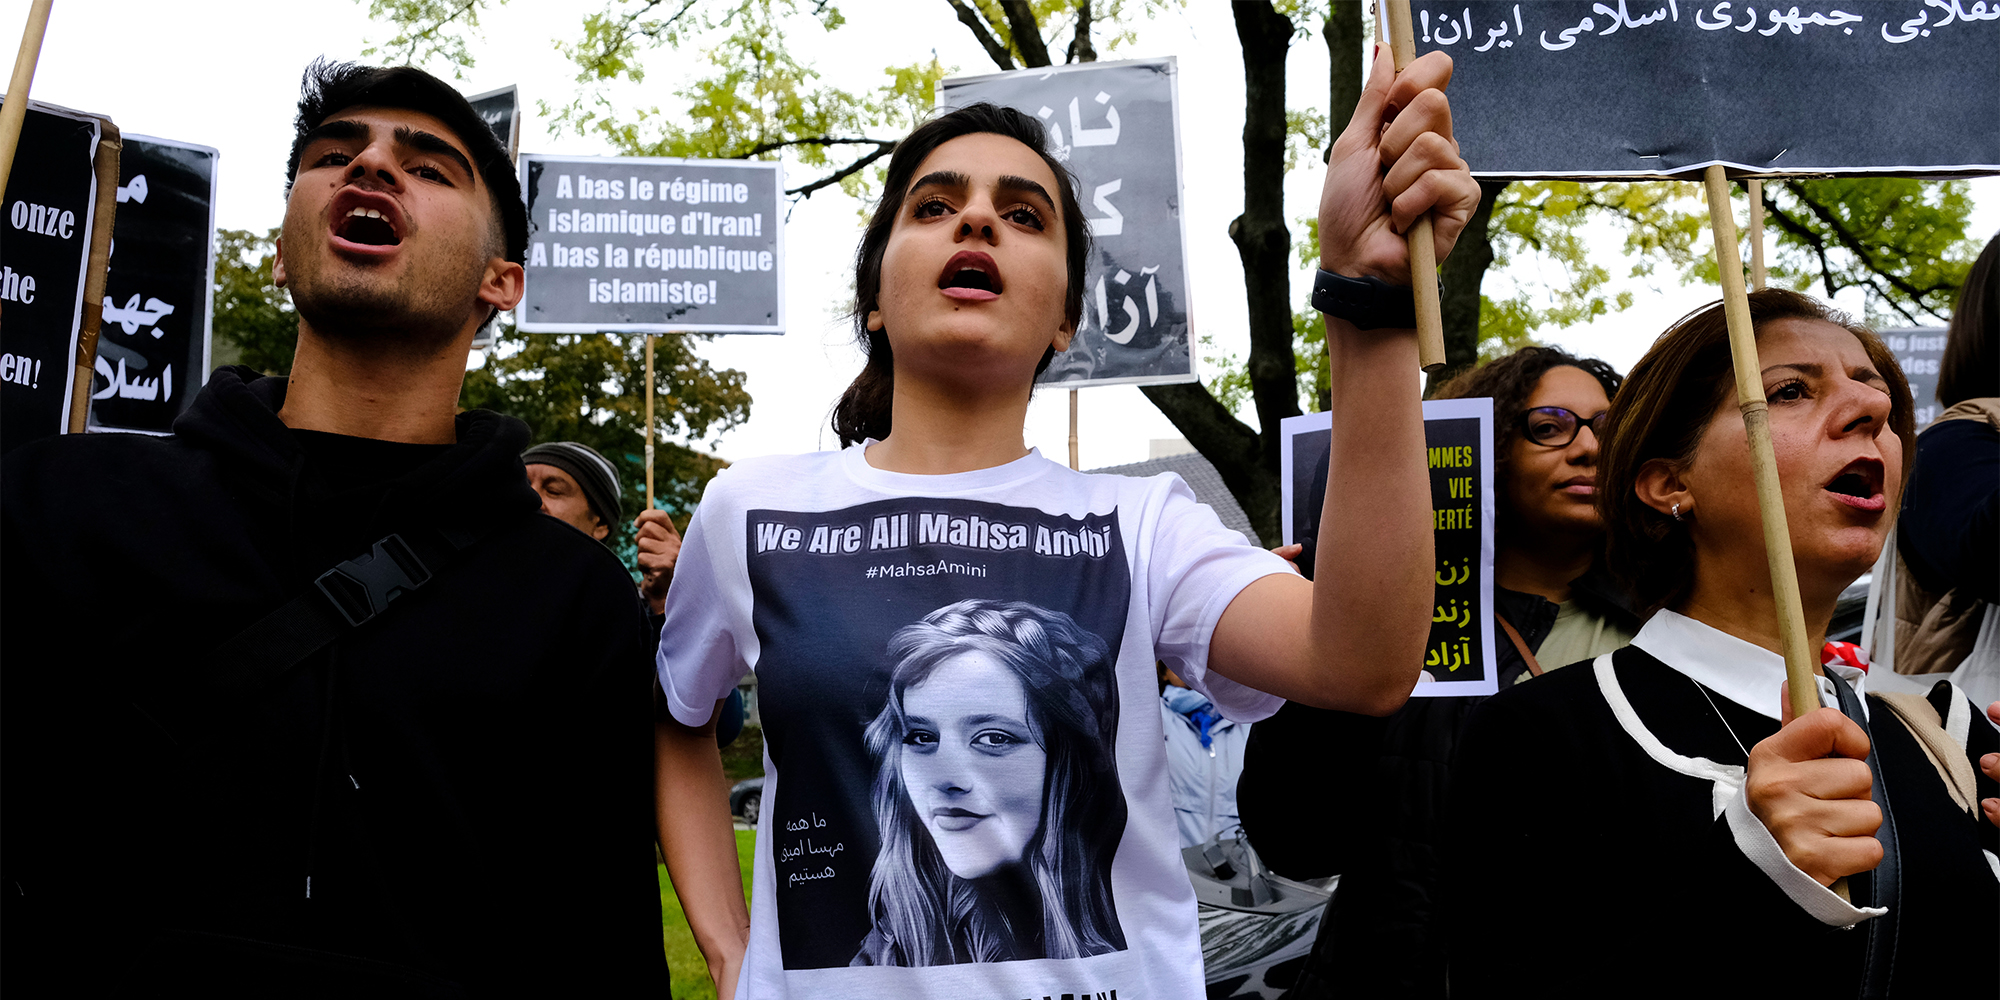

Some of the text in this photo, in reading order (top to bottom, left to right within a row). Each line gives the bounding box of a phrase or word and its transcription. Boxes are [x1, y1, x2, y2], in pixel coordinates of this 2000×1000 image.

[1419, 4, 1523, 51] ایران!
[1540, 0, 1679, 50] اسلامی
[1695, 1, 1863, 37] جمهوری
[555, 175, 749, 205] A bas le régime
[11, 200, 75, 239] onze
[548, 209, 762, 237] islamique d'Iran!
[530, 242, 773, 273] A bas la république
[589, 278, 717, 305] islamiste!
[92, 354, 172, 402] اسلا
[1427, 445, 1473, 469] MMES
[1448, 476, 1473, 499] VIE
[757, 513, 1111, 558] We Are All Mahsa Amini
[865, 560, 986, 579] #MahsaAmini
[1435, 557, 1470, 586] زن
[1432, 599, 1471, 629] زند
[1422, 636, 1471, 672] آزاد
[786, 812, 826, 832] ما همه
[781, 838, 844, 863] مهسا امینی
[789, 866, 836, 888] هستیم
